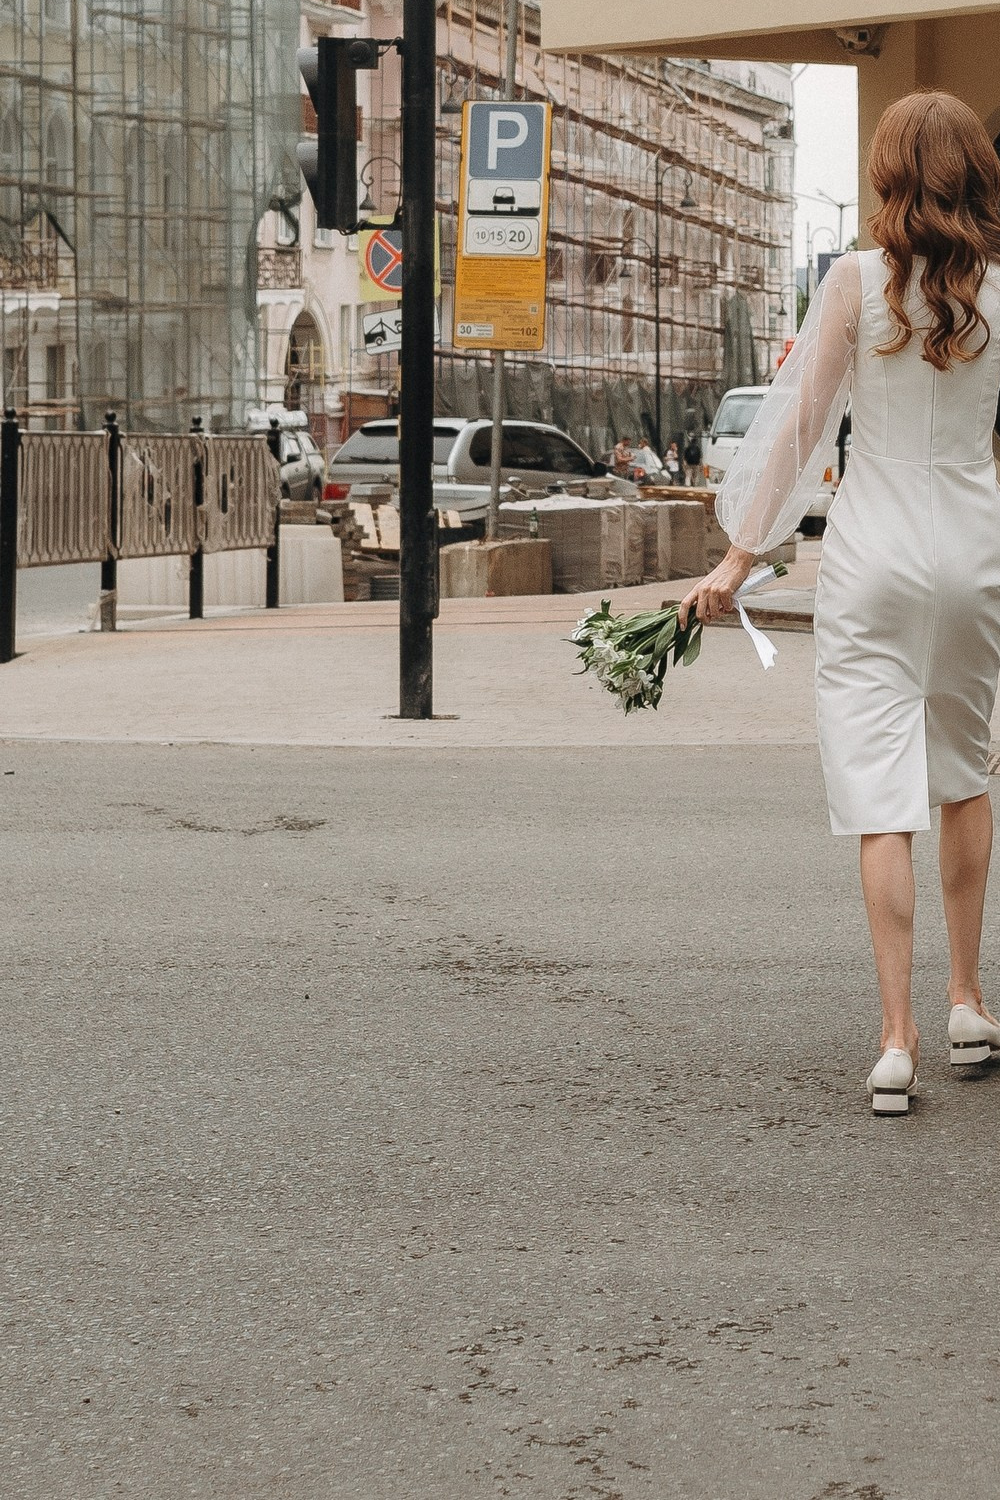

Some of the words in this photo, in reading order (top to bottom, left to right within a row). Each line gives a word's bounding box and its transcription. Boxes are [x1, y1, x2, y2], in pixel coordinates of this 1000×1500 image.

[487, 110, 529, 170] P
[475, 231, 486, 240] 10
[490, 230, 504, 241] 15
[508, 230, 526, 242] 20
[459, 325, 472, 335] 30
[520, 327, 538, 337] 102
